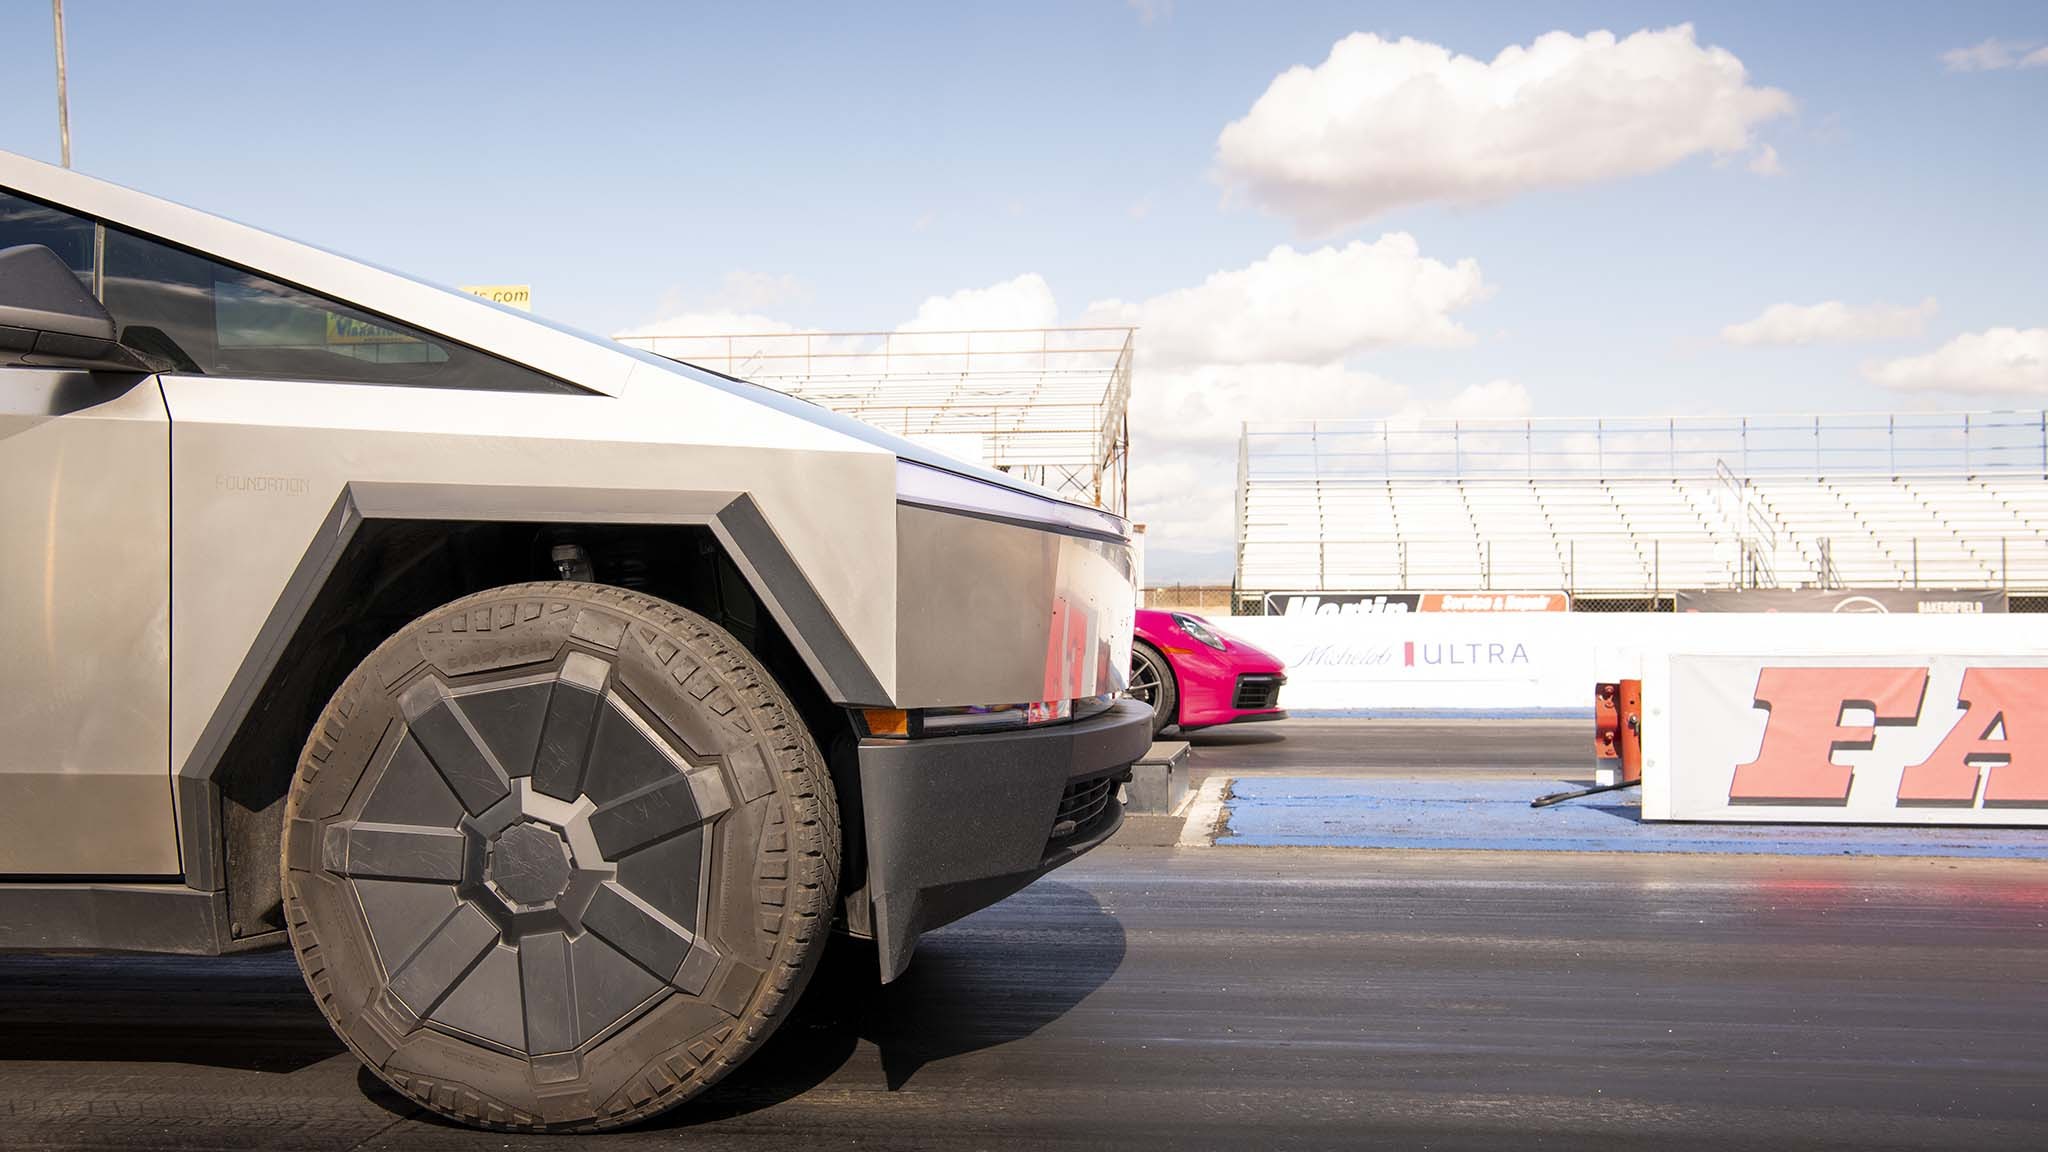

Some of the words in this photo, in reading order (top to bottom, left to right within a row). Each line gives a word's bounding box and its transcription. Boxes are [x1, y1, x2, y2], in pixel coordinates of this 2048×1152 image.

[215, 475, 310, 492] FOUNDATION
[1287, 644, 1392, 668] Michelob
[1423, 642, 1530, 664] ULTRA
[1728, 667, 2048, 809] FA
